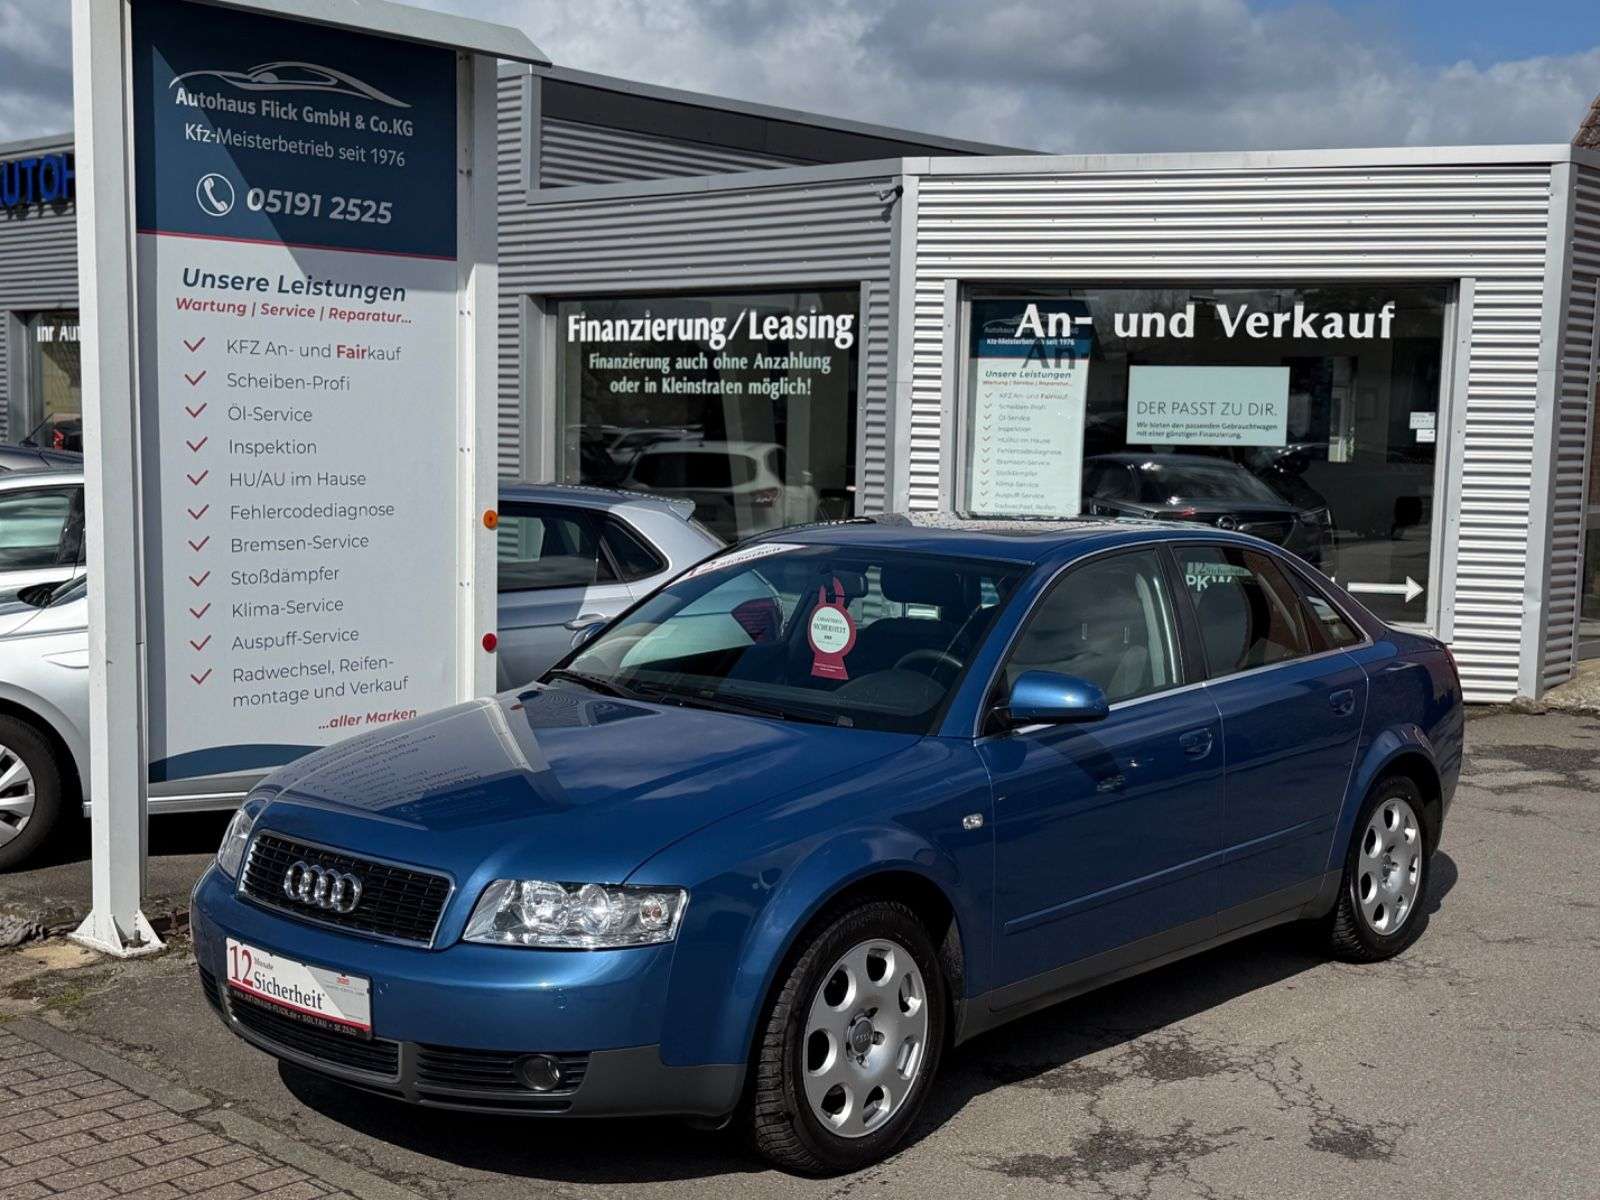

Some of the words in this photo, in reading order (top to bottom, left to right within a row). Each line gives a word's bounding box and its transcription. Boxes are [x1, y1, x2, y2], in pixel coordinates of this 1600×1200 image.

[176, 88, 256, 115] Autohaus
[261, 100, 297, 120] Flick
[303, 106, 350, 128] GmbH
[355, 115, 365, 129] &
[370, 116, 413, 136] Co.KG
[185, 123, 334, 158] Kfz-Meisterbetrieb
[339, 146, 366, 163] seit
[371, 148, 405, 167] 1976
[0, 153, 76, 207] UTOH
[246, 188, 321, 217] 05191
[329, 197, 393, 224] 2525
[183, 268, 269, 292] Unsere
[277, 275, 406, 304] Leistungen
[176, 297, 247, 317] Wartung
[260, 303, 316, 318] Service
[329, 307, 412, 324] Reparatur...
[1014, 303, 1093, 338] An-
[1114, 305, 1195, 339] und
[1215, 301, 1397, 339] Verkauf
[567, 305, 855, 350] Finanzierung/Leasing
[227, 340, 260, 355] KFZ
[265, 341, 294, 356] An-
[299, 343, 331, 358] und
[336, 344, 402, 361] Fairkauf
[589, 352, 670, 374] Finanzierung
[675, 352, 708, 370] auch
[713, 353, 748, 370] ohne
[753, 352, 832, 374] Anzahlung
[227, 373, 350, 391] Scheiben-Profi
[610, 377, 640, 393] oder
[644, 376, 657, 393] in
[661, 378, 743, 395] Kleinstraten
[748, 377, 812, 400] möglich!
[228, 402, 312, 422] Öl-Service
[1136, 401, 1166, 415] DER
[1171, 401, 1216, 416] PASST
[1220, 402, 1242, 416] ZU
[1248, 402, 1278, 416] DIR.
[229, 439, 317, 457] Inspektion
[230, 470, 285, 488] HU/AU
[291, 471, 312, 486] im
[317, 472, 366, 487] Hause
[230, 502, 395, 520] Fehlercodediagnose
[231, 534, 370, 553] Bremsen-Service
[231, 566, 340, 586] Stoßdämpfer
[232, 598, 344, 619] Klima-Service
[231, 628, 359, 651] Auspuff-Service
[233, 659, 335, 683] Radwechsel,
[339, 656, 394, 673] Reifen-
[233, 688, 309, 707] montage
[314, 682, 345, 699] und
[349, 676, 409, 696] Verkauf
[365, 708, 417, 724] Marken
[230, 945, 253, 987] 12
